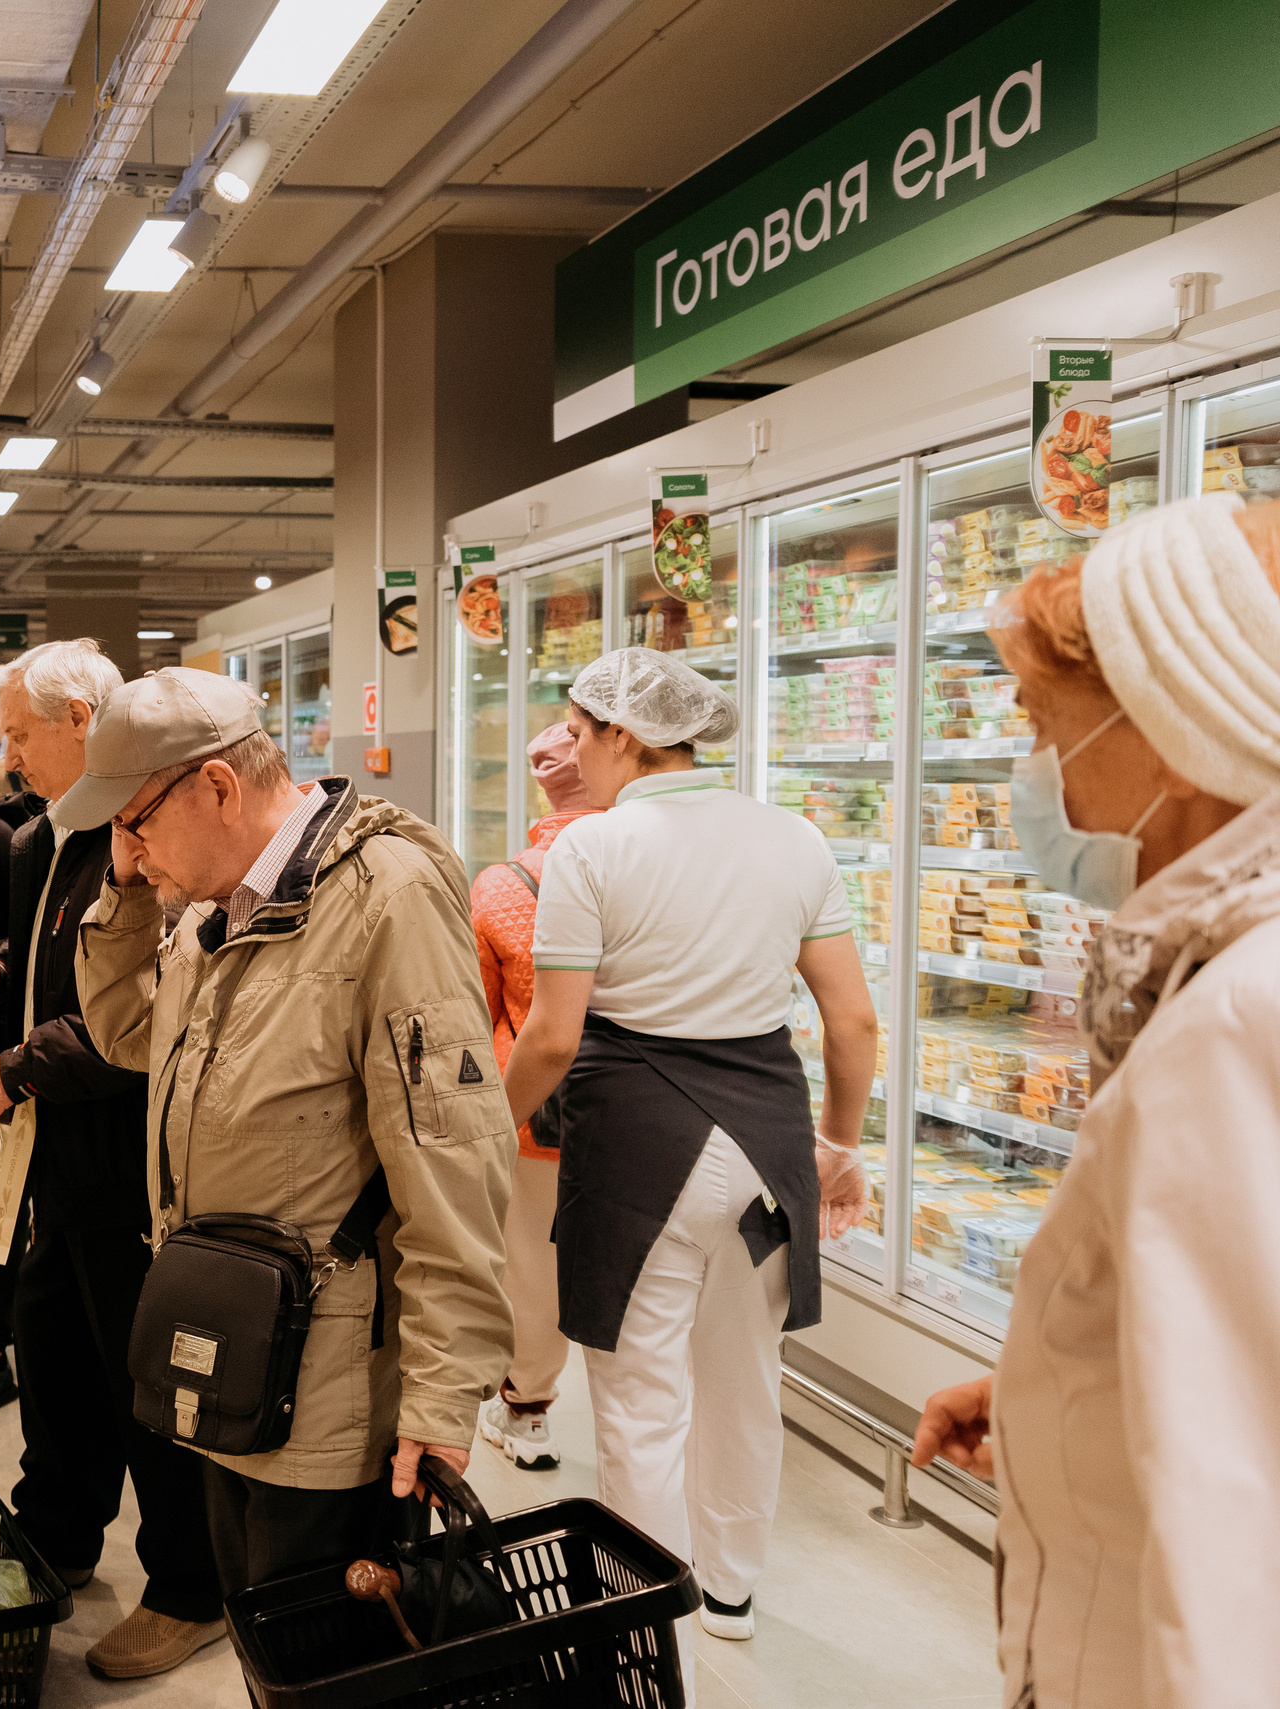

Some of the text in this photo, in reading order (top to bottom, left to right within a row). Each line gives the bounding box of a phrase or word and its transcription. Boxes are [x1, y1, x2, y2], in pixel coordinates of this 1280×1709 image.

[655, 59, 1042, 329] Готовая еда
[1059, 355, 1095, 366] Вторые
[1059, 367, 1091, 378] блюда
